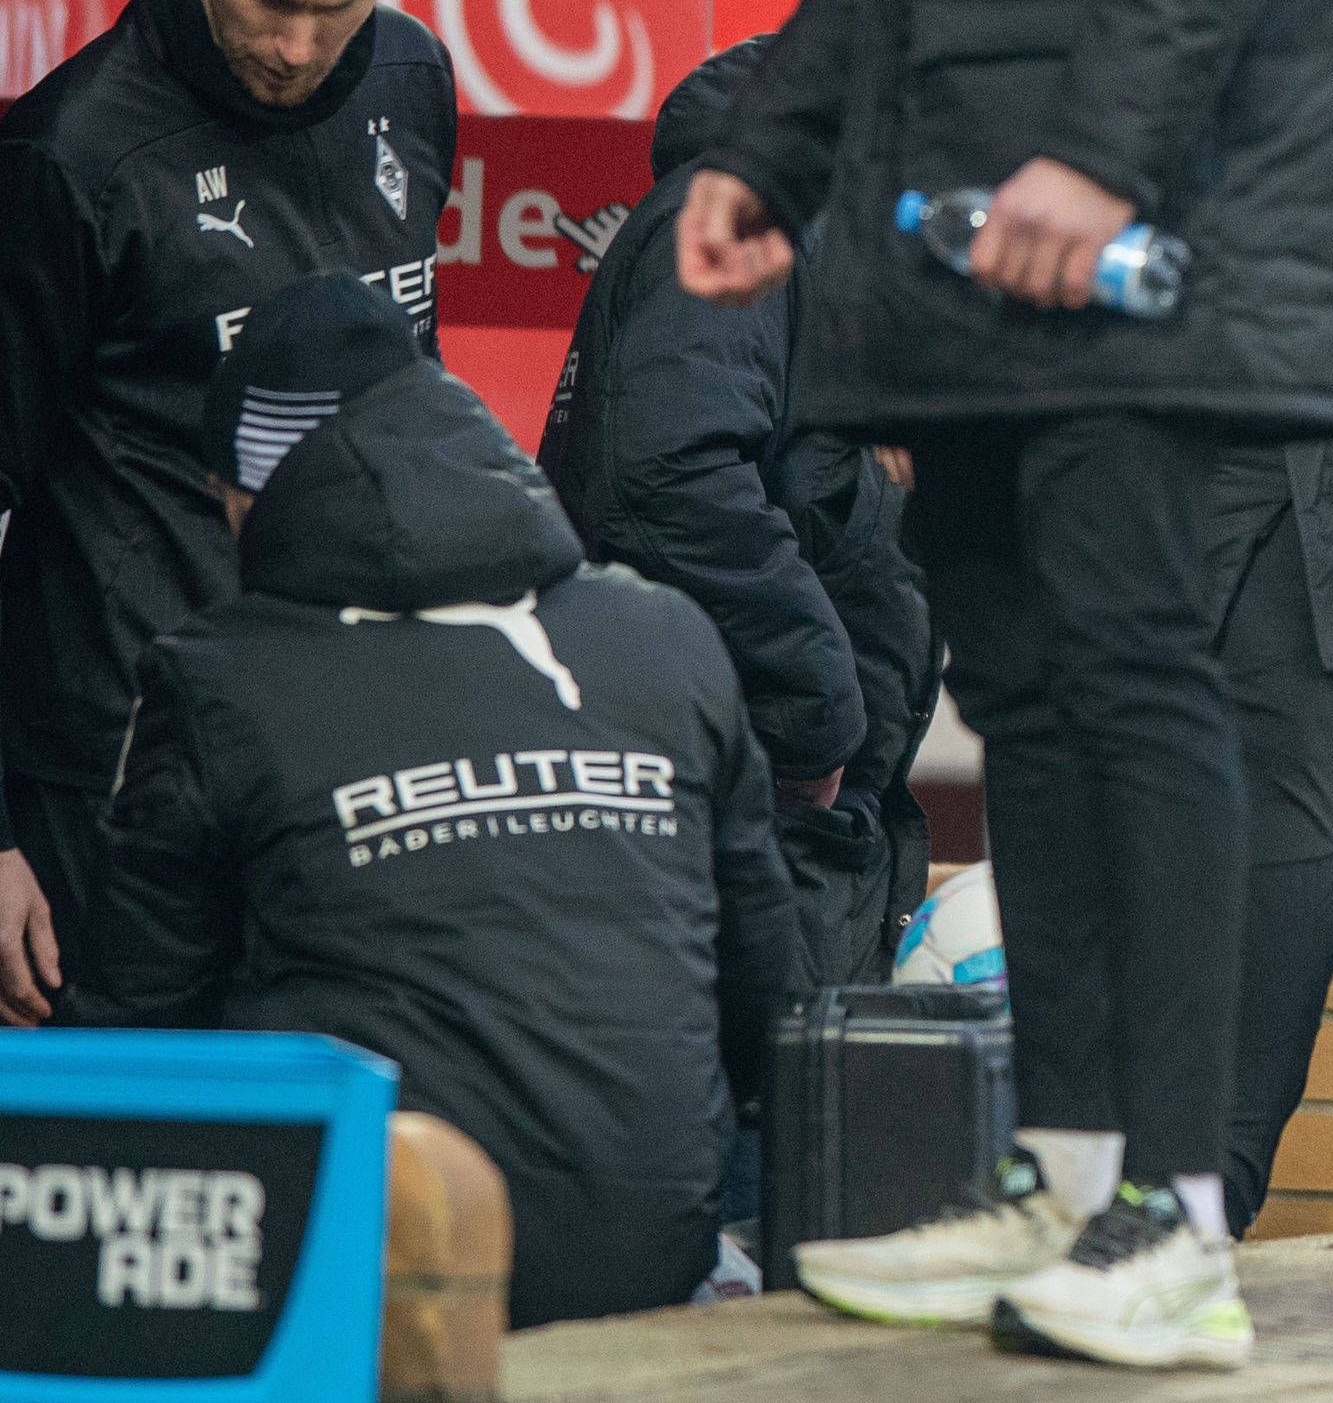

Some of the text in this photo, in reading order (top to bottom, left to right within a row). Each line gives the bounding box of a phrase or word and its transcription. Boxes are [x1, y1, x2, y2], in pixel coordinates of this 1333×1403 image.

[196, 165, 228, 204] AW
[333, 749, 675, 829] REUTER
[506, 808, 678, 837] LEUCHTEN
[98, 1239, 263, 1312] ADE
